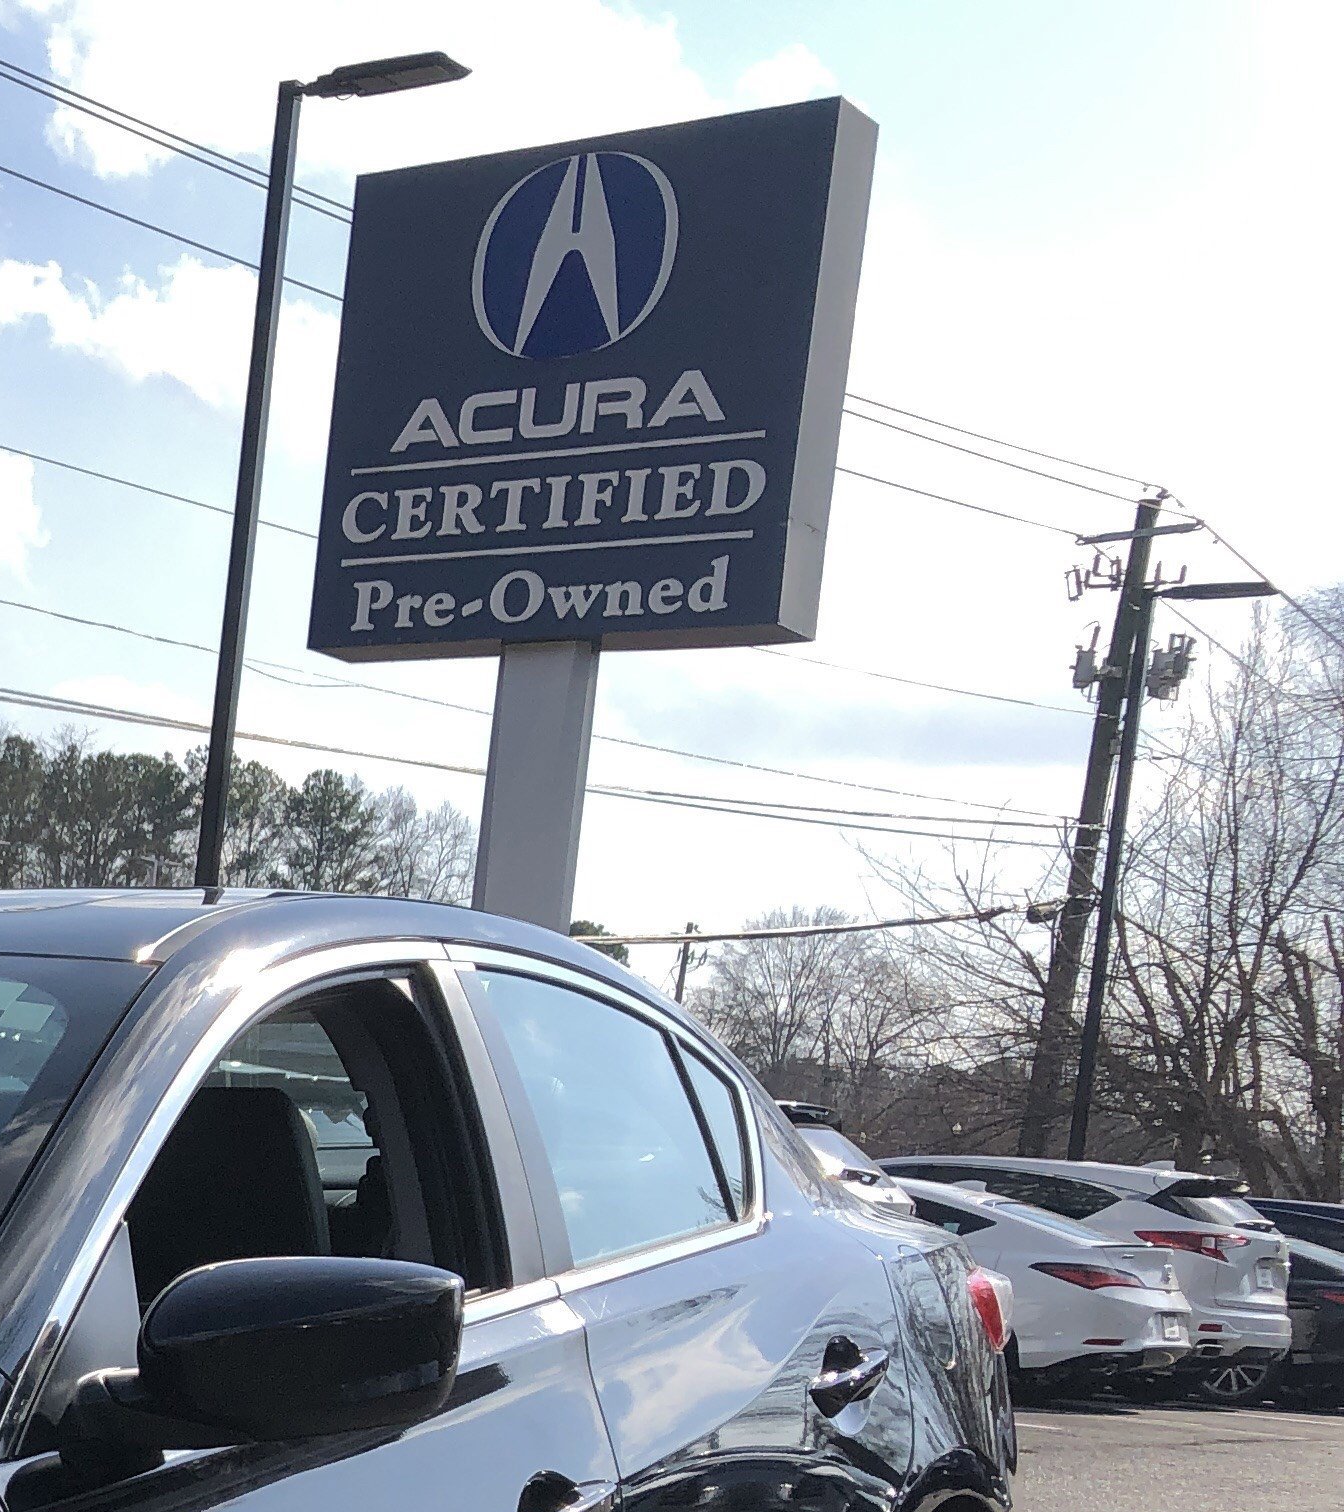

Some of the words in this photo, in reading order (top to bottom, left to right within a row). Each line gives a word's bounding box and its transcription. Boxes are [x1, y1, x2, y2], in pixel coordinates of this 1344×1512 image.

[390, 369, 726, 453] ACURA
[341, 458, 766, 544] CERTIFIED
[350, 555, 729, 632] Pre-Owned
